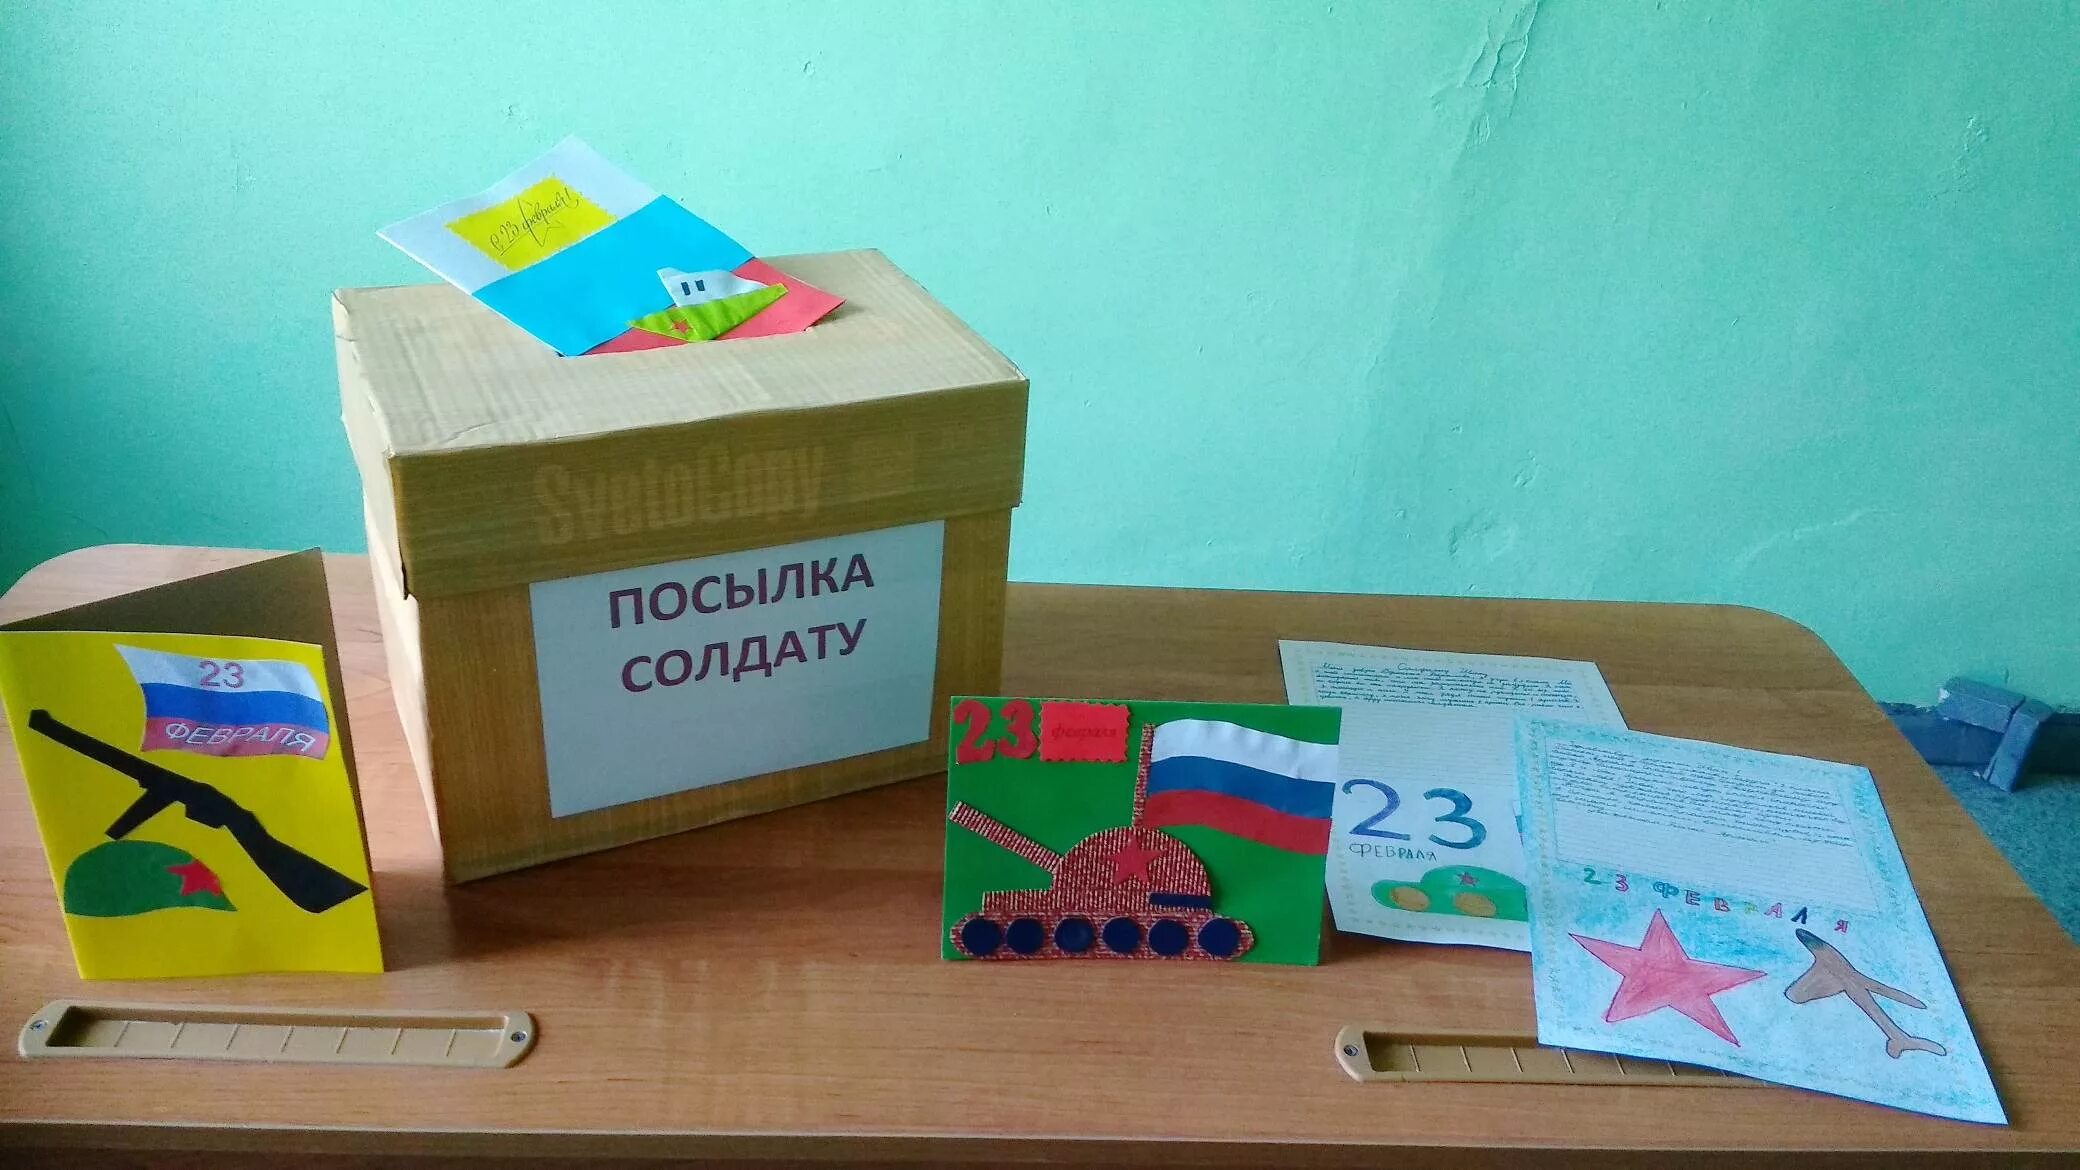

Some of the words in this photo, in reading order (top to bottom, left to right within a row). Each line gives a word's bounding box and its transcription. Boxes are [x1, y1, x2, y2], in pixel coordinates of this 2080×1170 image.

[499, 220, 520, 243] 23
[533, 440, 826, 545] SvetoCopy
[608, 552, 876, 629] ПОСЫЛКА
[199, 659, 245, 689] 23
[621, 617, 868, 693] СОЛДАТУ
[164, 721, 316, 753] ФЕВРАЛЯ
[953, 698, 1039, 764] 23
[1341, 778, 1488, 850] 23
[1349, 842, 1438, 863] ФЕВРАЛЯ
